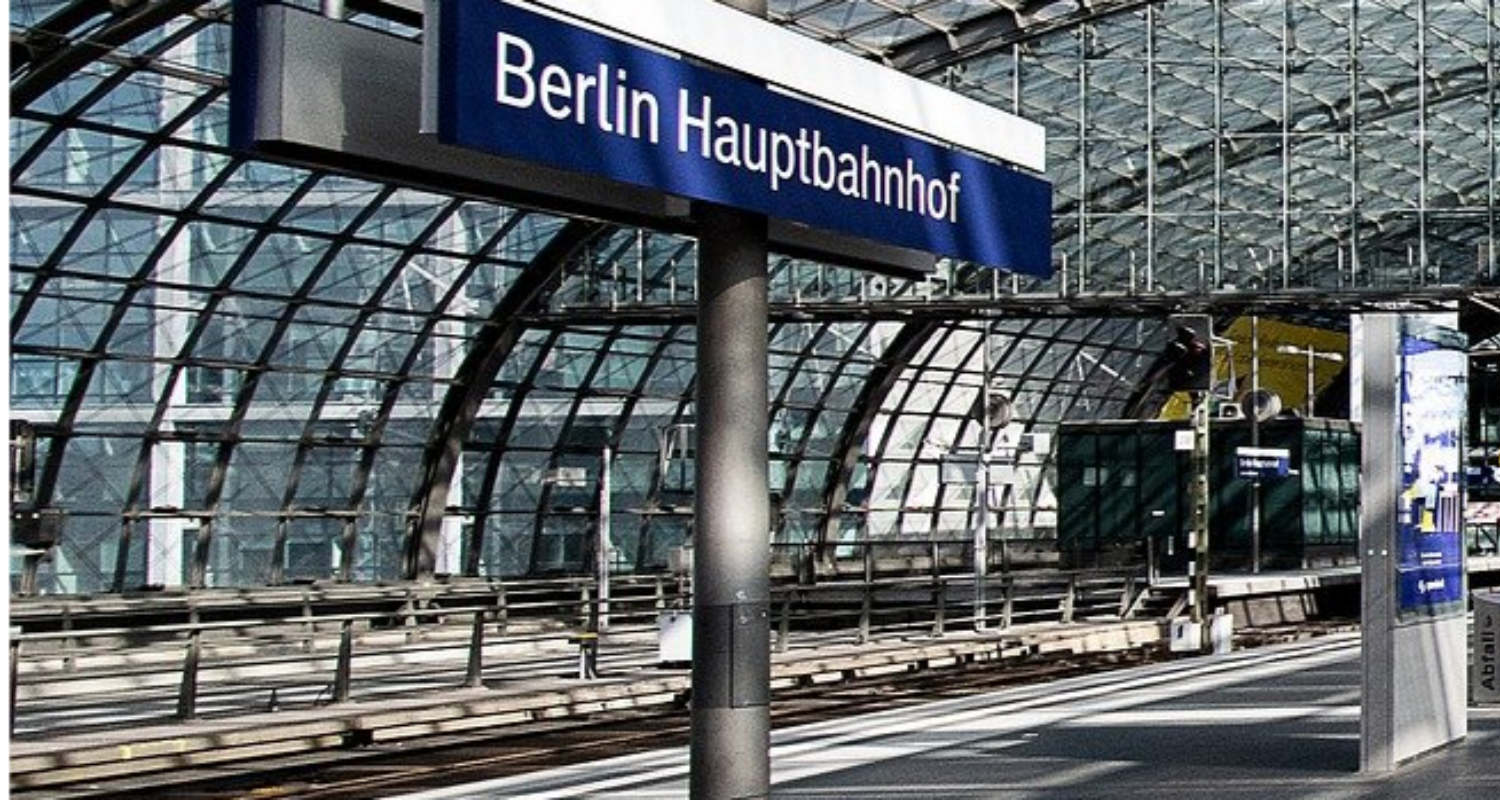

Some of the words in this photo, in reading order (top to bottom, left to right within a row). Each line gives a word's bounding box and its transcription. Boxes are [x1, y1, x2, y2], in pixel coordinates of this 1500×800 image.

[496, 31, 659, 144] Berlin
[678, 89, 962, 223] Hauptbahnhof
[1480, 631, 1496, 691] Abfall
